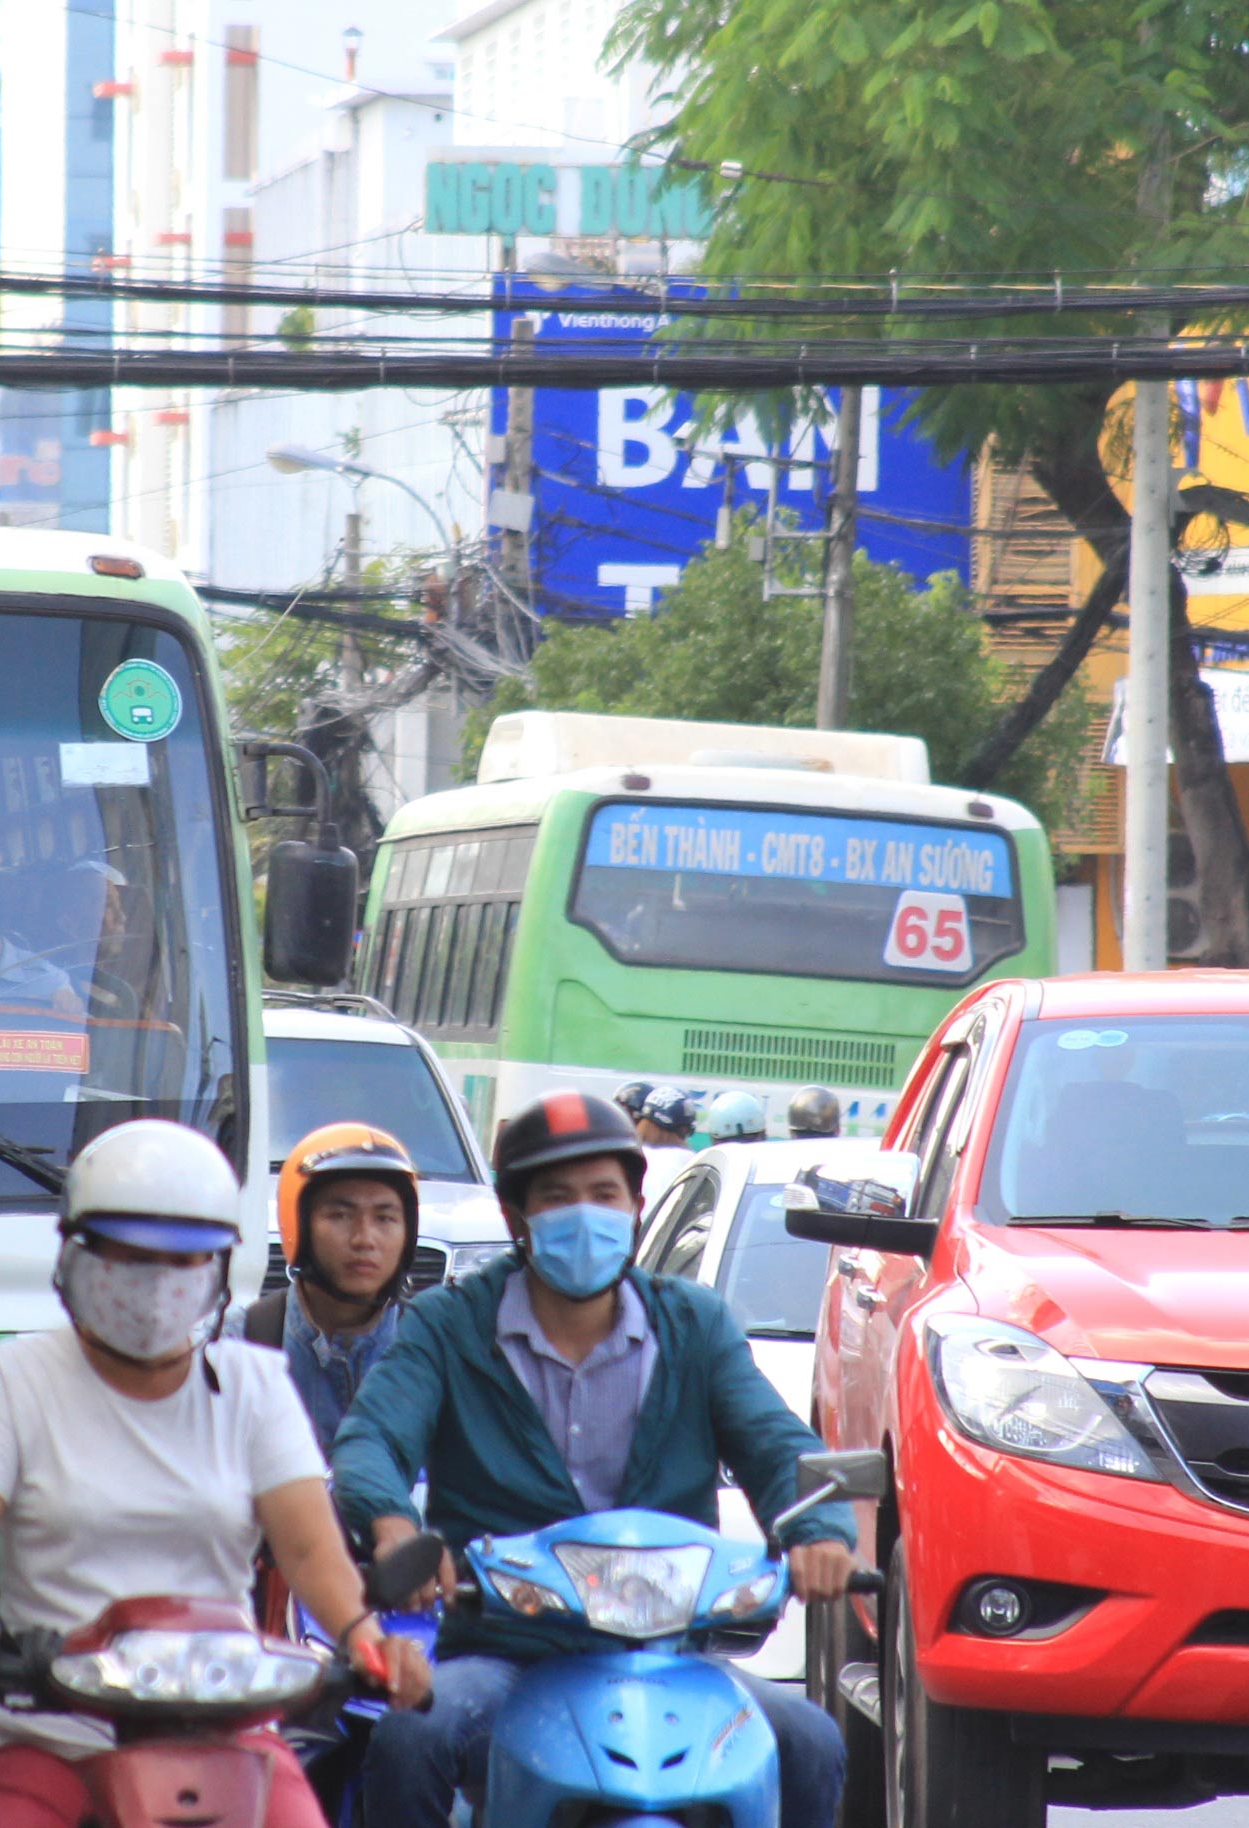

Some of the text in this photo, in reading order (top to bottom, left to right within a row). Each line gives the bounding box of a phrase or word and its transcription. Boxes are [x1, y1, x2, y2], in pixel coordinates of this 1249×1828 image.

[609, 805, 659, 866] BẾN
[663, 816, 742, 872] THÀNH
[761, 831, 825, 878] CMT8
[845, 837, 878, 881] BX
[881, 840, 916, 885] AN
[895, 905, 965, 964] 65
